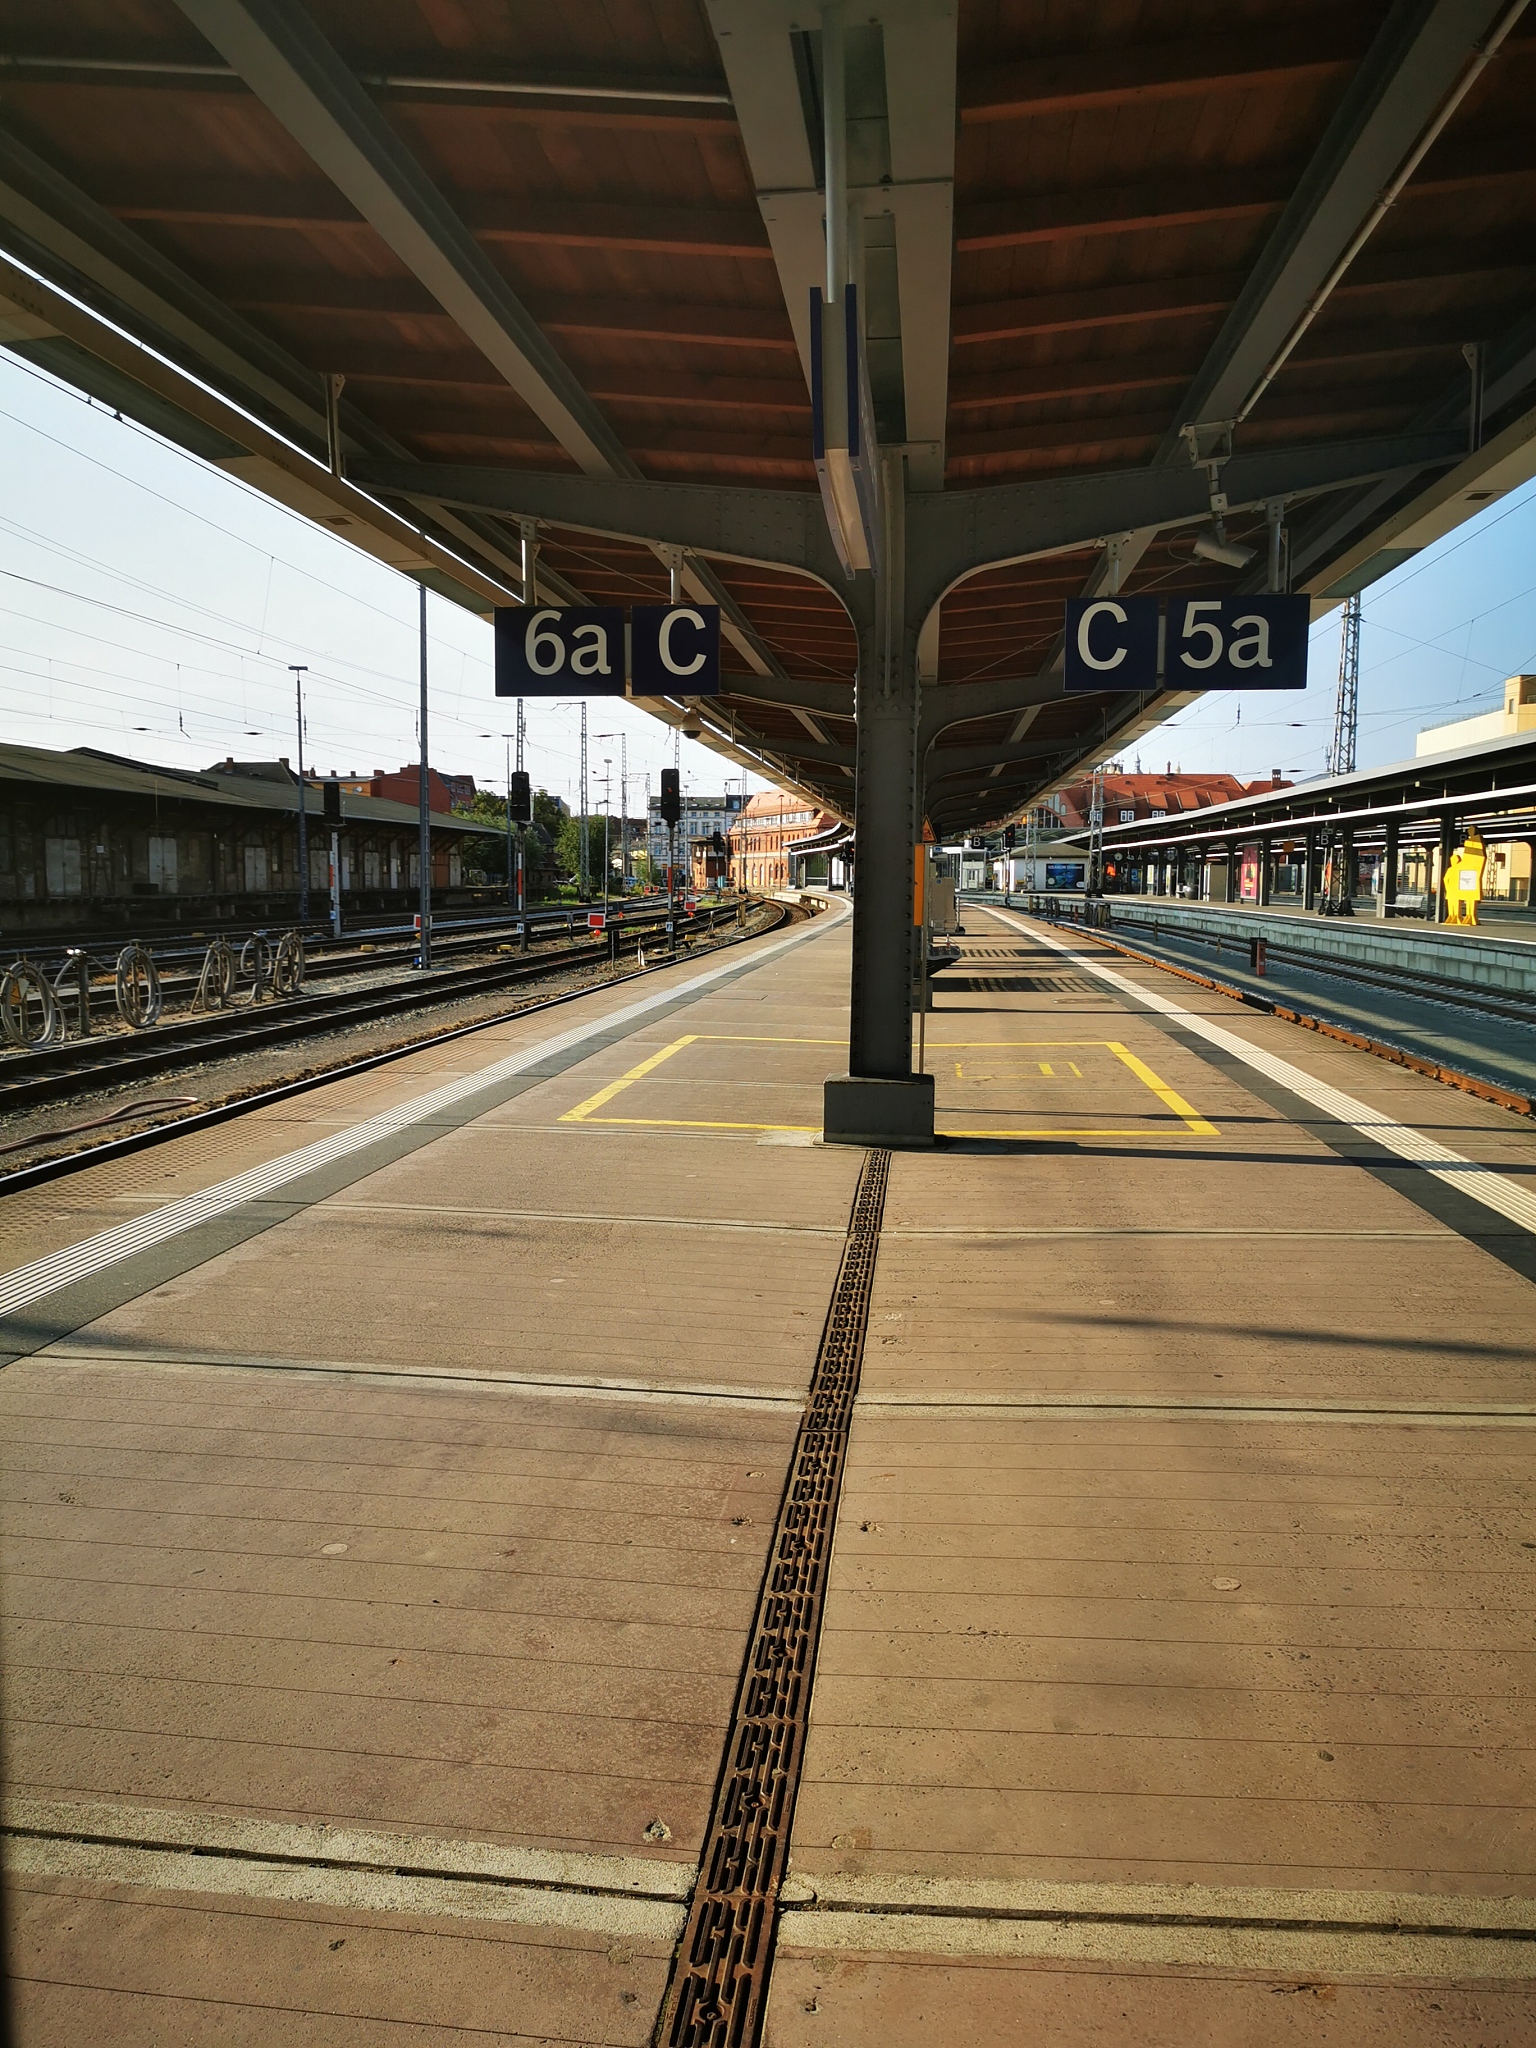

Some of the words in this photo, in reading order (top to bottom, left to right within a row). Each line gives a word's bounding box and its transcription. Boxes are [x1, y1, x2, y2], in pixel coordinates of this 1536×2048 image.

[525, 609, 612, 676] 6a
[658, 608, 707, 676] C
[1082, 601, 1128, 670] C
[1180, 600, 1273, 669] 5a
[973, 837, 981, 847] B
[1321, 835, 1329, 845] B
